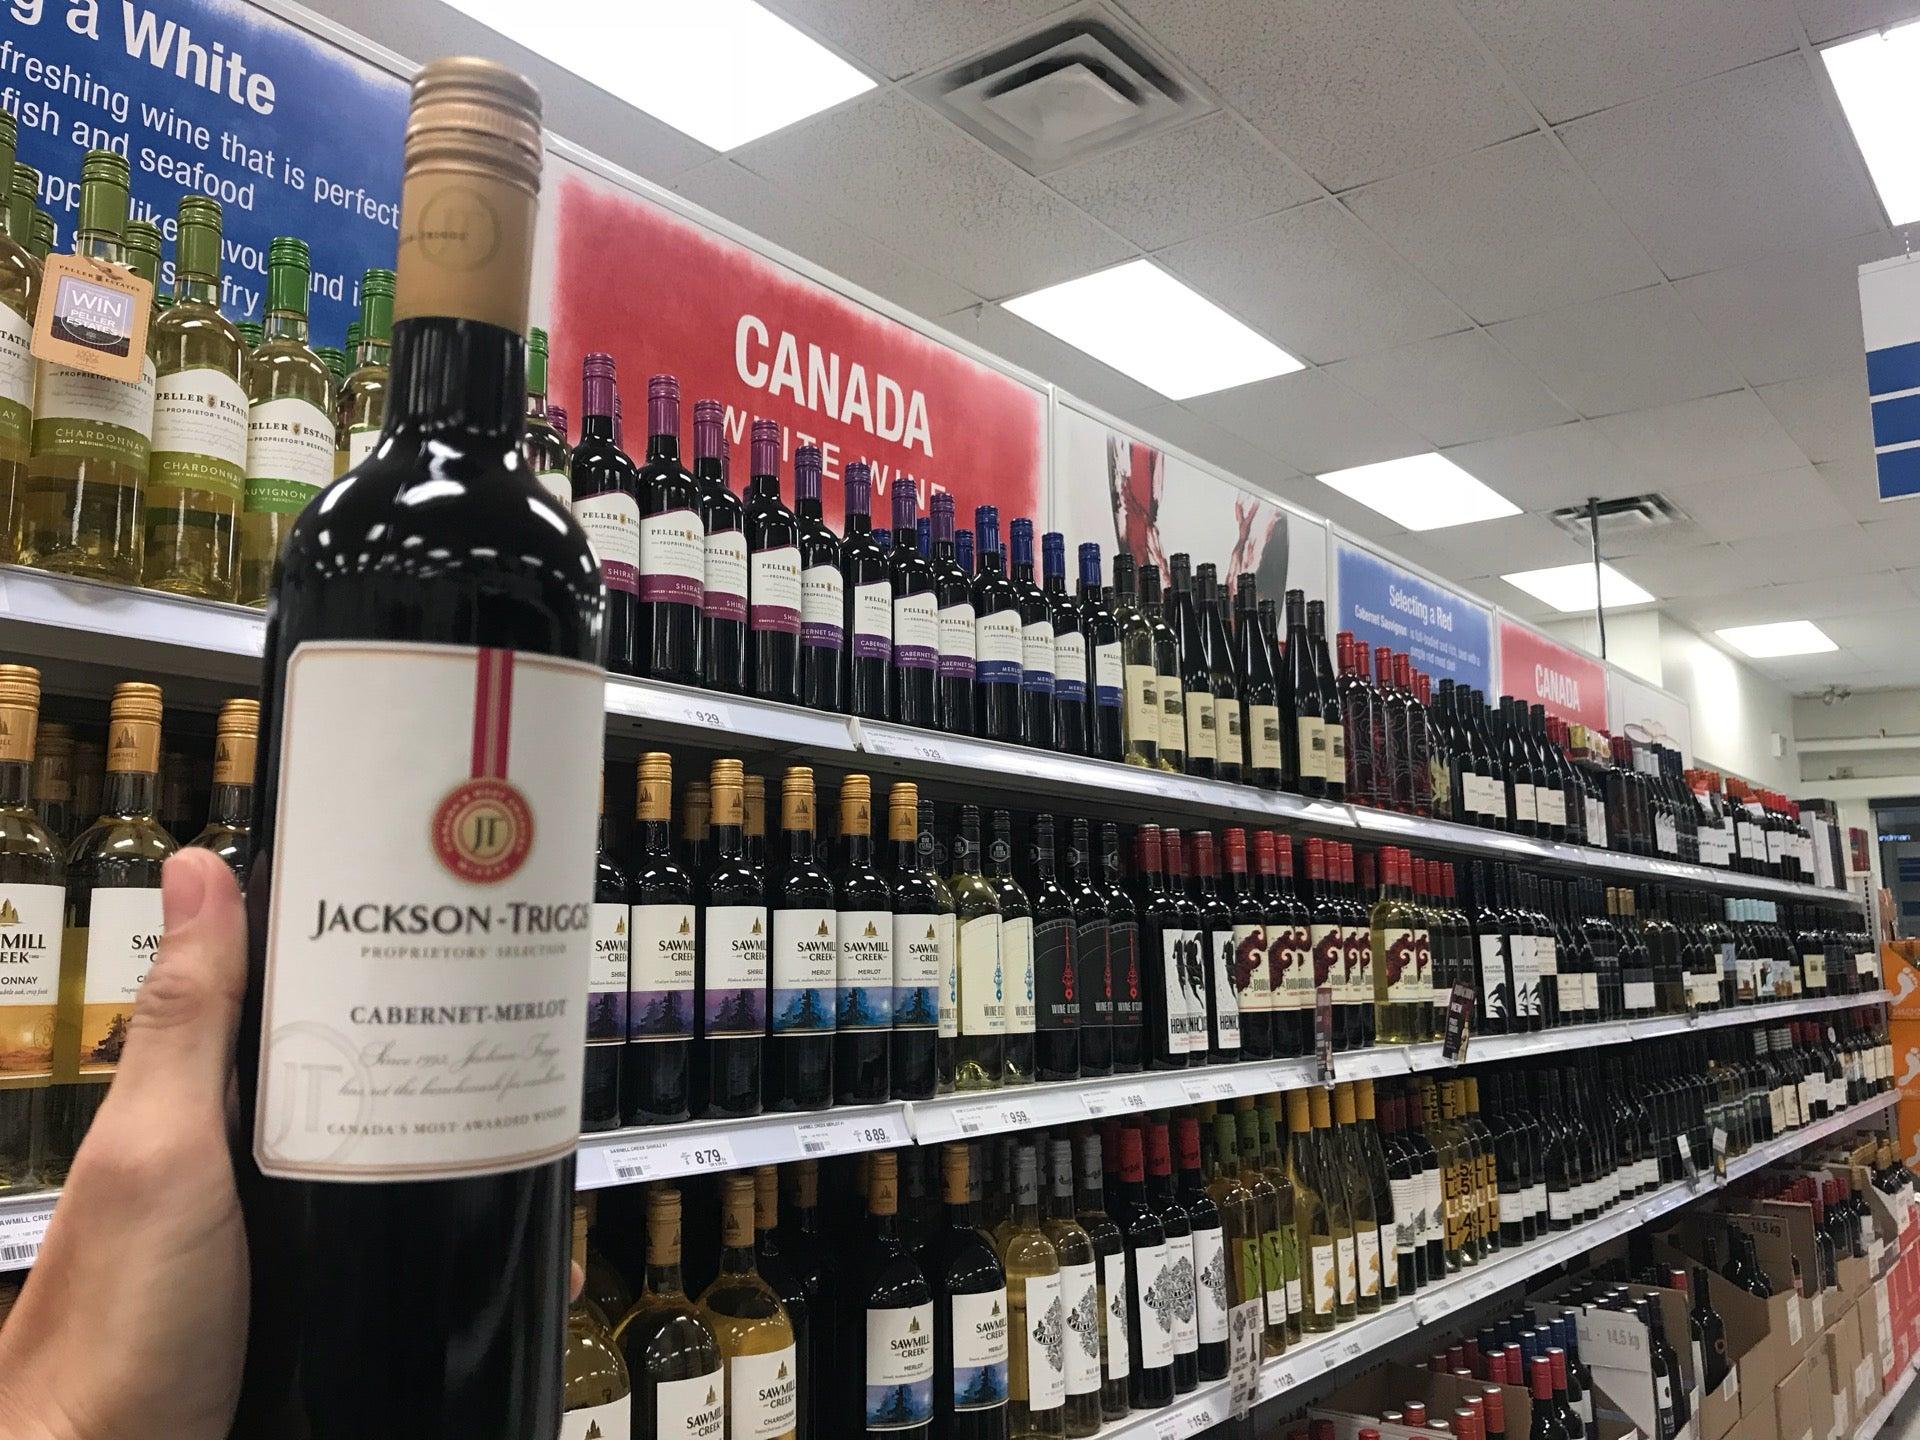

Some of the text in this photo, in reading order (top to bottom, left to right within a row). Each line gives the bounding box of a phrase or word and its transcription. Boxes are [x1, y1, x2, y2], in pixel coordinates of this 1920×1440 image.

[66, 0, 99, 41] a
[123, 1, 276, 116] White
[1, 86, 255, 212] fish and seafood
[141, 102, 210, 151] wine
[220, 131, 275, 180] that
[284, 156, 305, 191] is
[314, 175, 400, 231] perfect
[129, 197, 178, 242] like
[71, 289, 122, 318] WIN
[221, 274, 260, 317] fry
[70, 308, 116, 328] PELLER
[735, 313, 934, 458] CANADA
[156, 393, 204, 403] PELLER
[3, 410, 17, 421] AY
[55, 428, 145, 453] CHARDONNAY
[1389, 584, 1453, 633] Selecting a Red
[1535, 663, 1580, 712] CANADA
[0, 933, 47, 949] MILL
[843, 941, 890, 953] SAWMILL
[0, 952, 30, 964] EEK
[809, 953, 833, 962] CREEK
[855, 953, 883, 962] CREEK
[1, 976, 38, 985] ONNAY
[350, 1000, 568, 1026] CABERNET-MERLOT
[891, 1334, 930, 1350] SAWMILL
[901, 1348, 926, 1359] CREEK
[770, 1395, 792, 1409] CREEK
